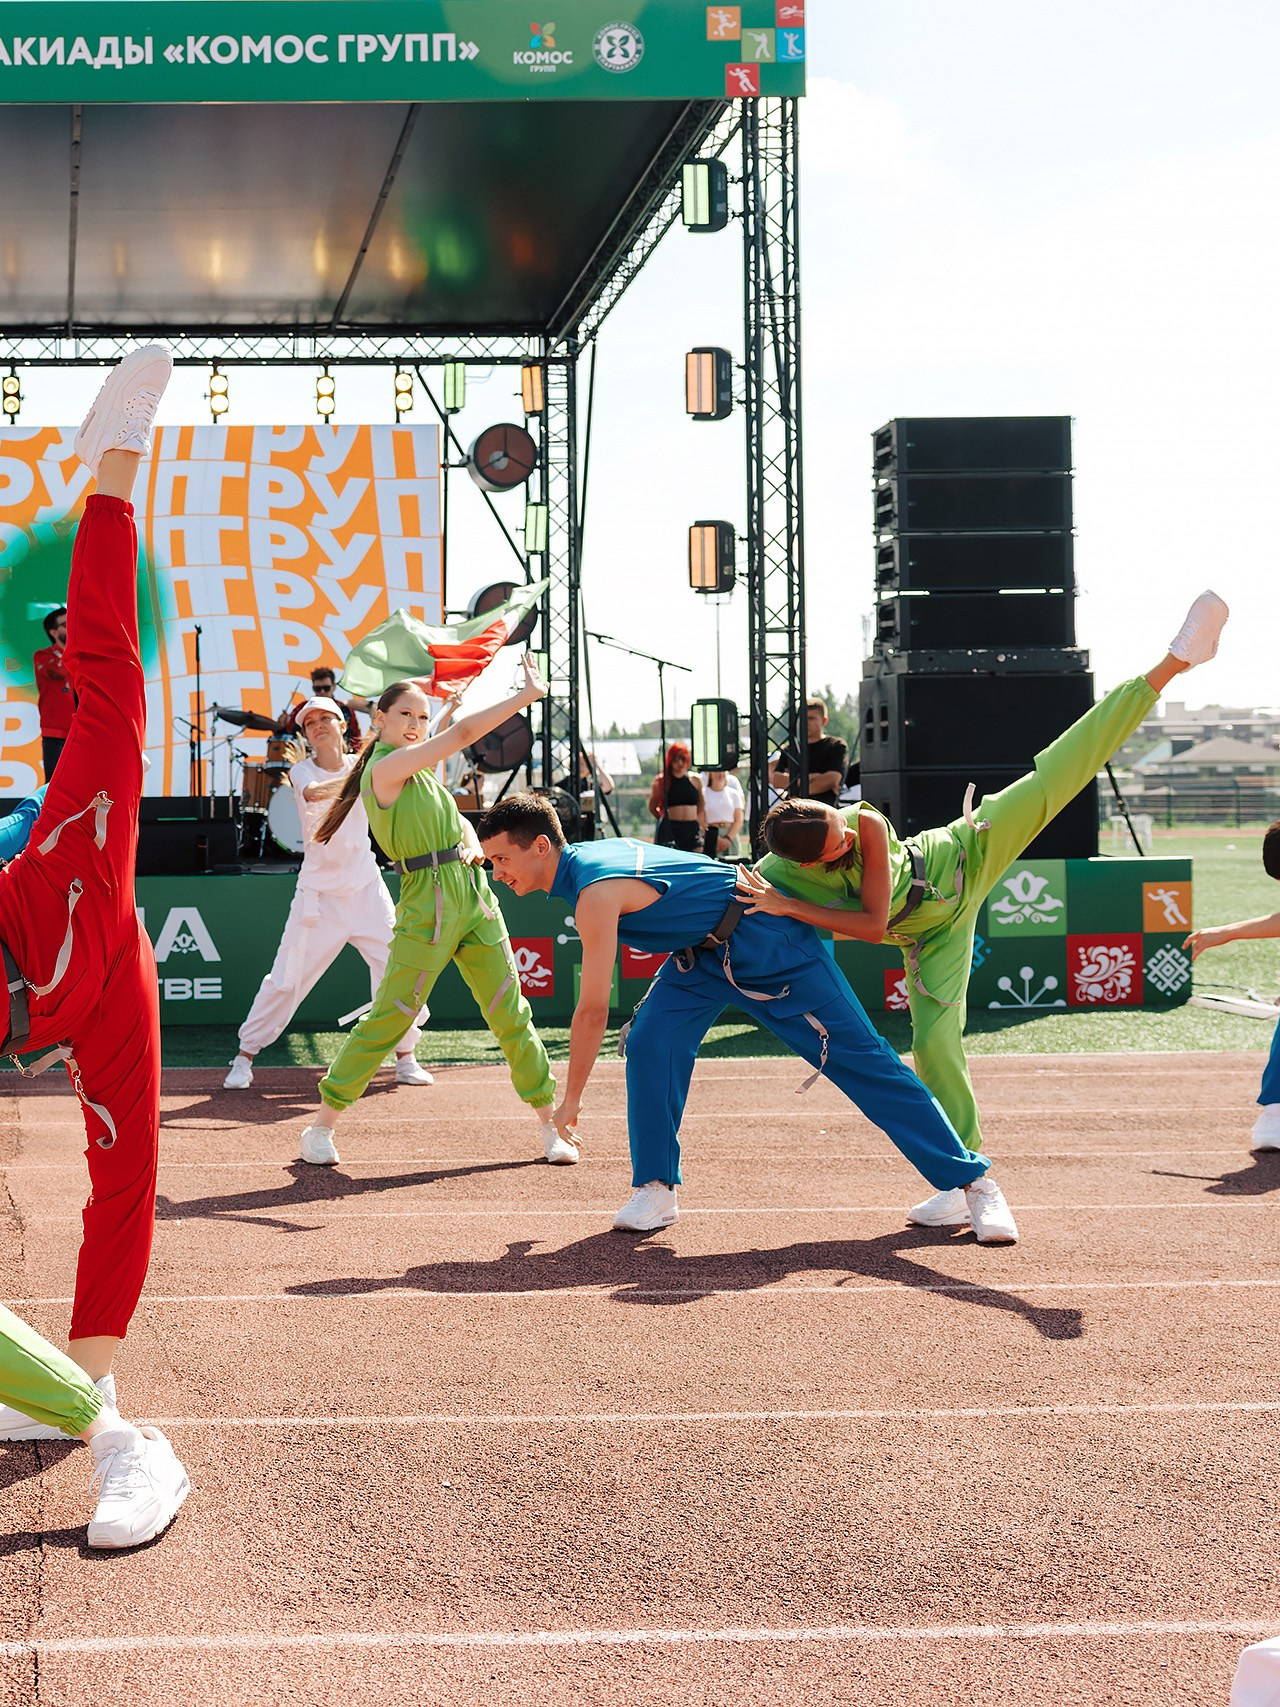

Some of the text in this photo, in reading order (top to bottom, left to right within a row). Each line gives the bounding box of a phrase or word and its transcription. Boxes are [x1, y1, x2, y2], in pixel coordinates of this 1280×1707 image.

[163, 34, 329, 64] «КОМОС
[337, 33, 480, 63] ГРУПП»
[513, 51, 573, 65] КОМОС
